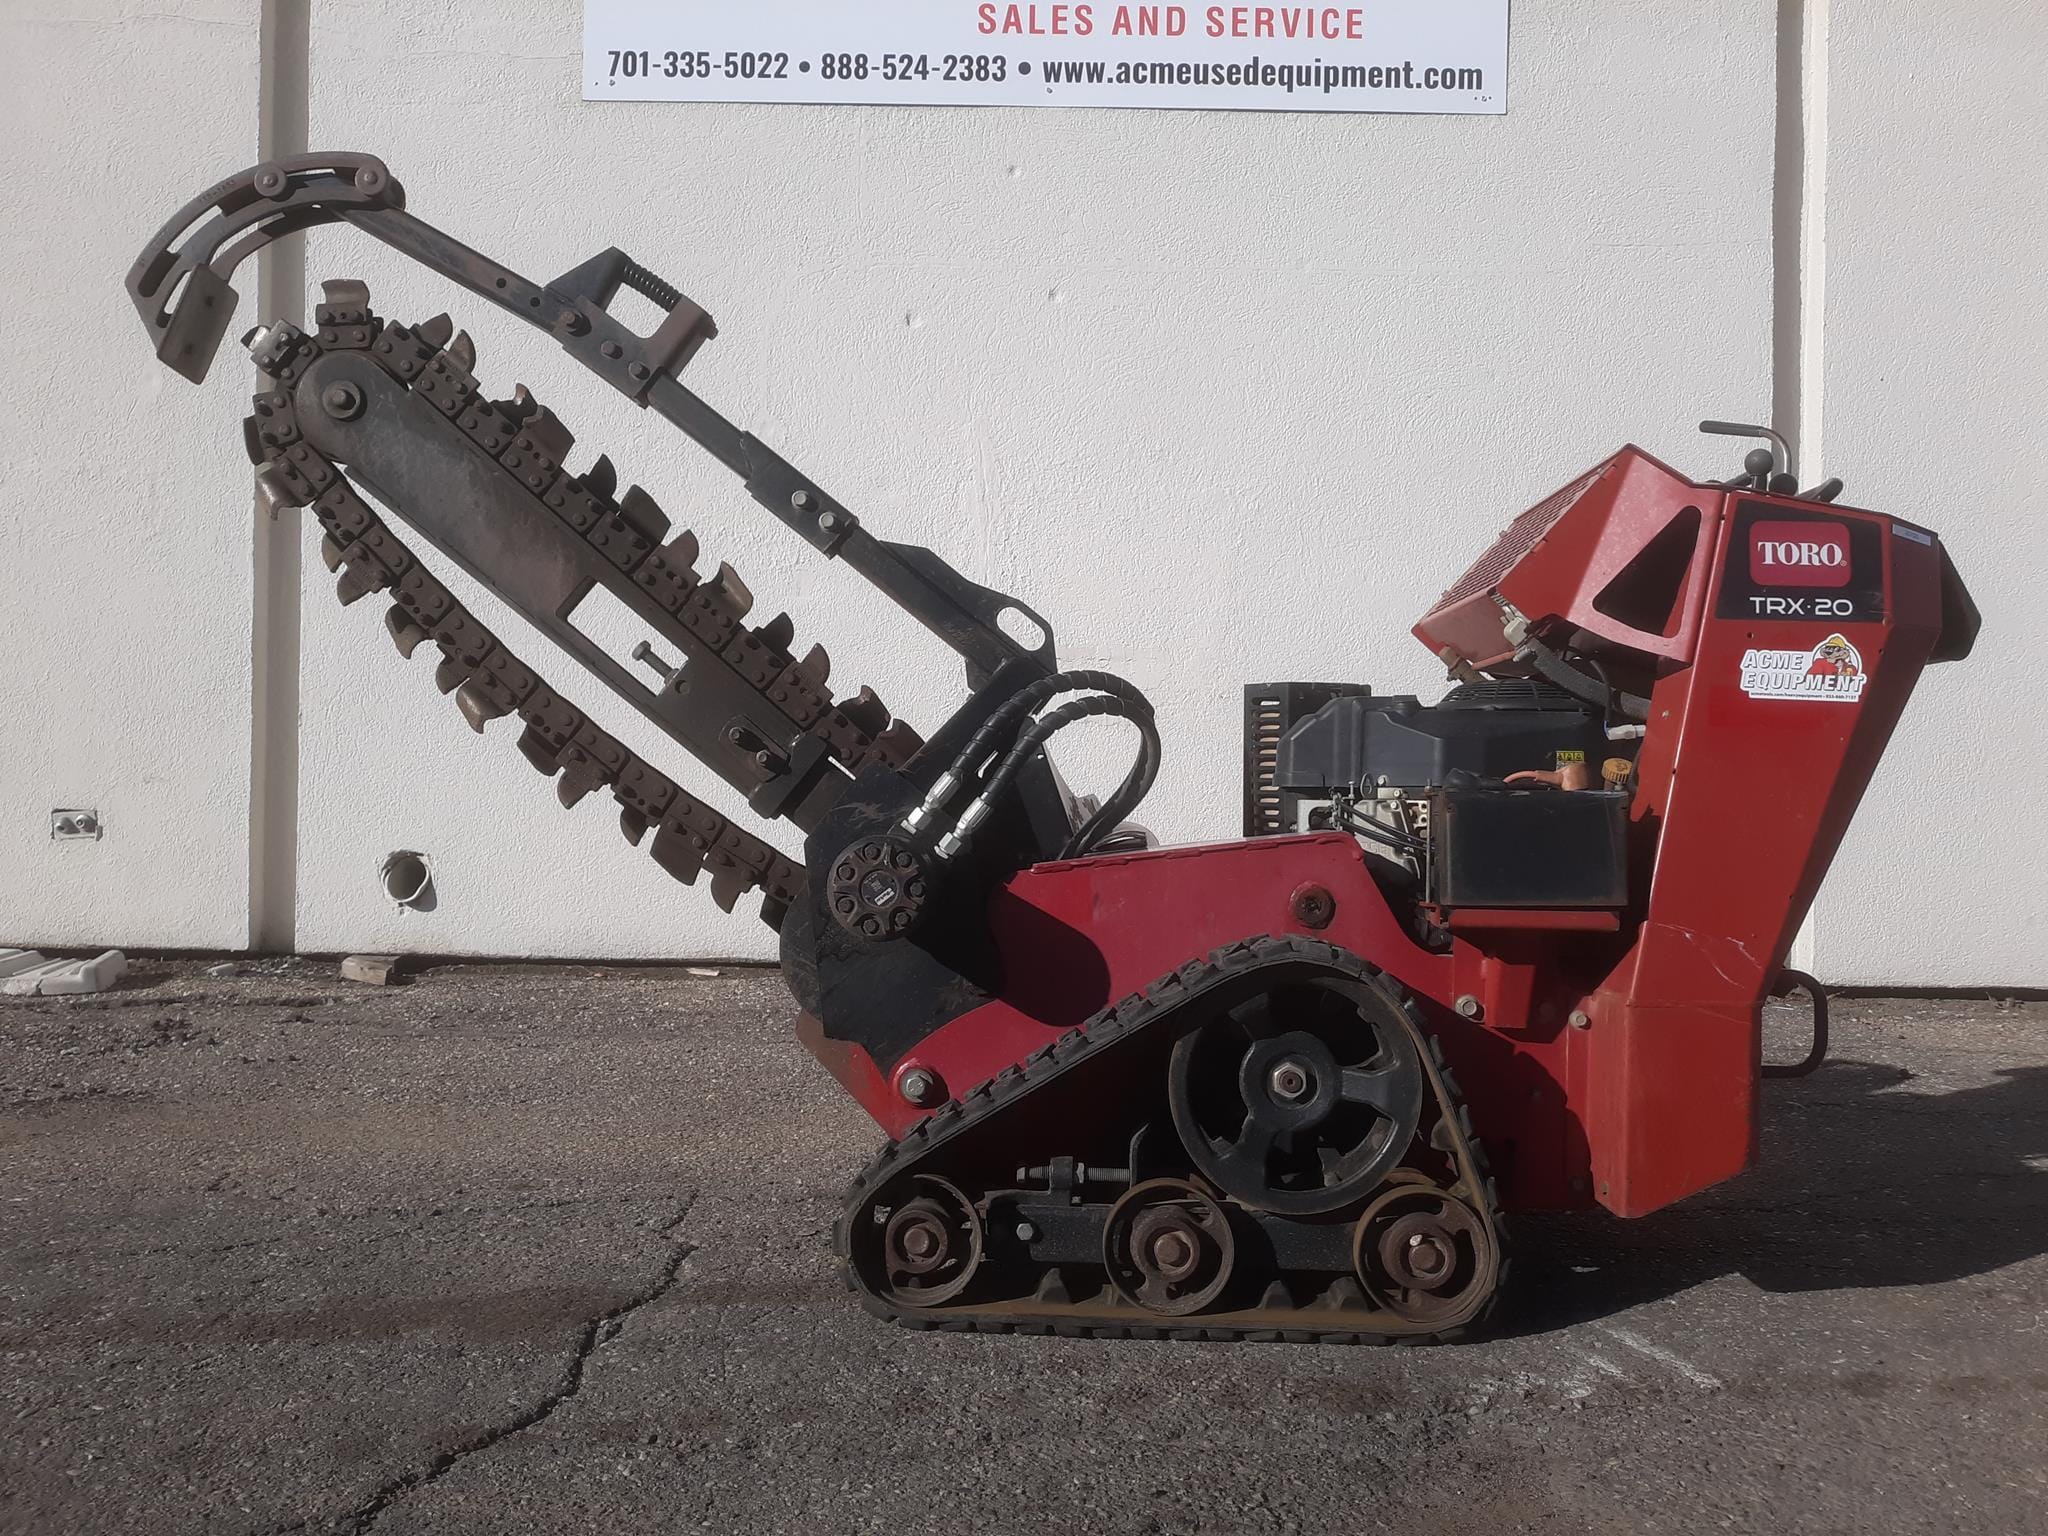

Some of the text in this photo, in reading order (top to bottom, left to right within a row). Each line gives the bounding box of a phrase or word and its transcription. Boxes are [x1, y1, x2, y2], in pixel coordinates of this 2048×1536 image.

[978, 3, 1363, 40] SALES AND SERVICE
[608, 51, 1483, 93] 701-335-5022 888-524-2383 www.acmeusedequipment.com
[1757, 541, 1843, 567] TORO
[1743, 651, 1804, 670] ACME
[1743, 671, 1864, 692] EQUIPMENT
